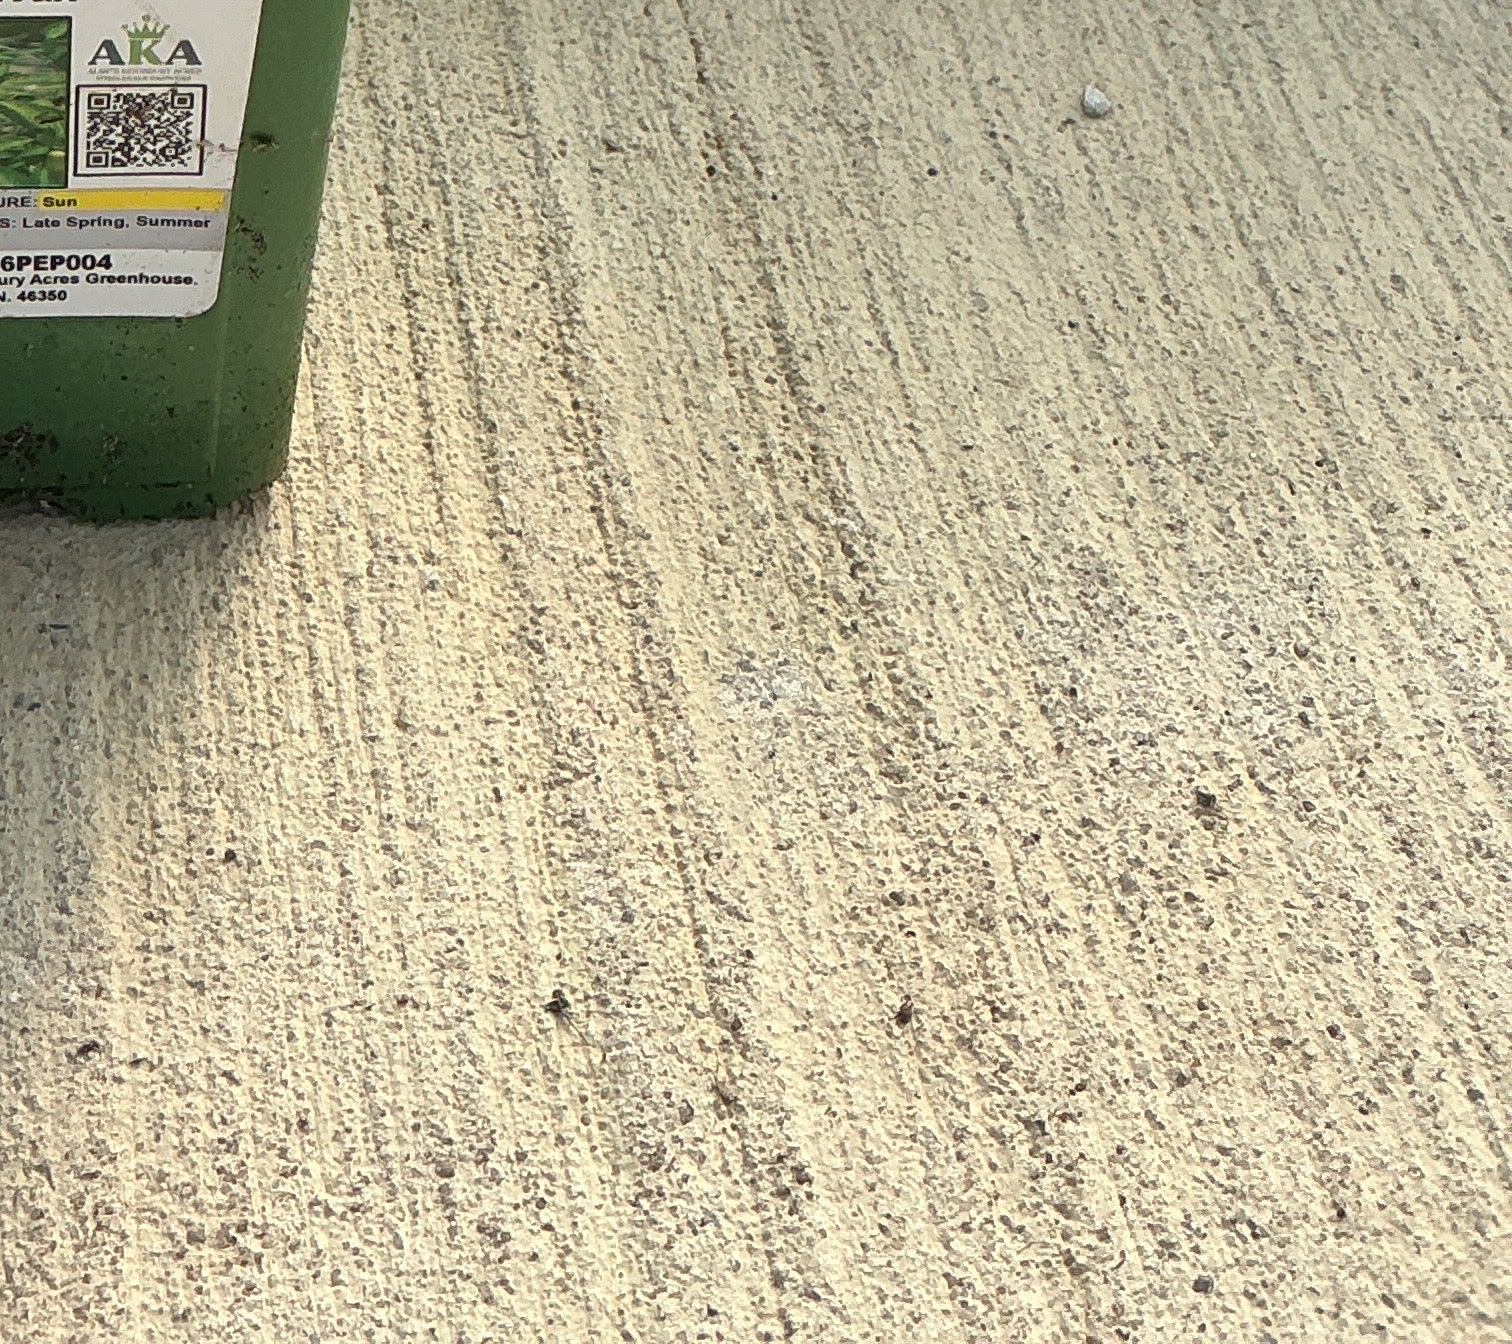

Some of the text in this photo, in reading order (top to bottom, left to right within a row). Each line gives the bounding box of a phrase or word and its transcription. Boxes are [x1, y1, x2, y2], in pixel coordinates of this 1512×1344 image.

[88, 38, 203, 66] AKA
[42, 196, 78, 208] Sun
[22, 216, 60, 229] Late
[66, 215, 130, 230] Spring,
[136, 215, 211, 229] Summer
[29, 273, 80, 286] Acres
[16, 290, 68, 302] 46350
